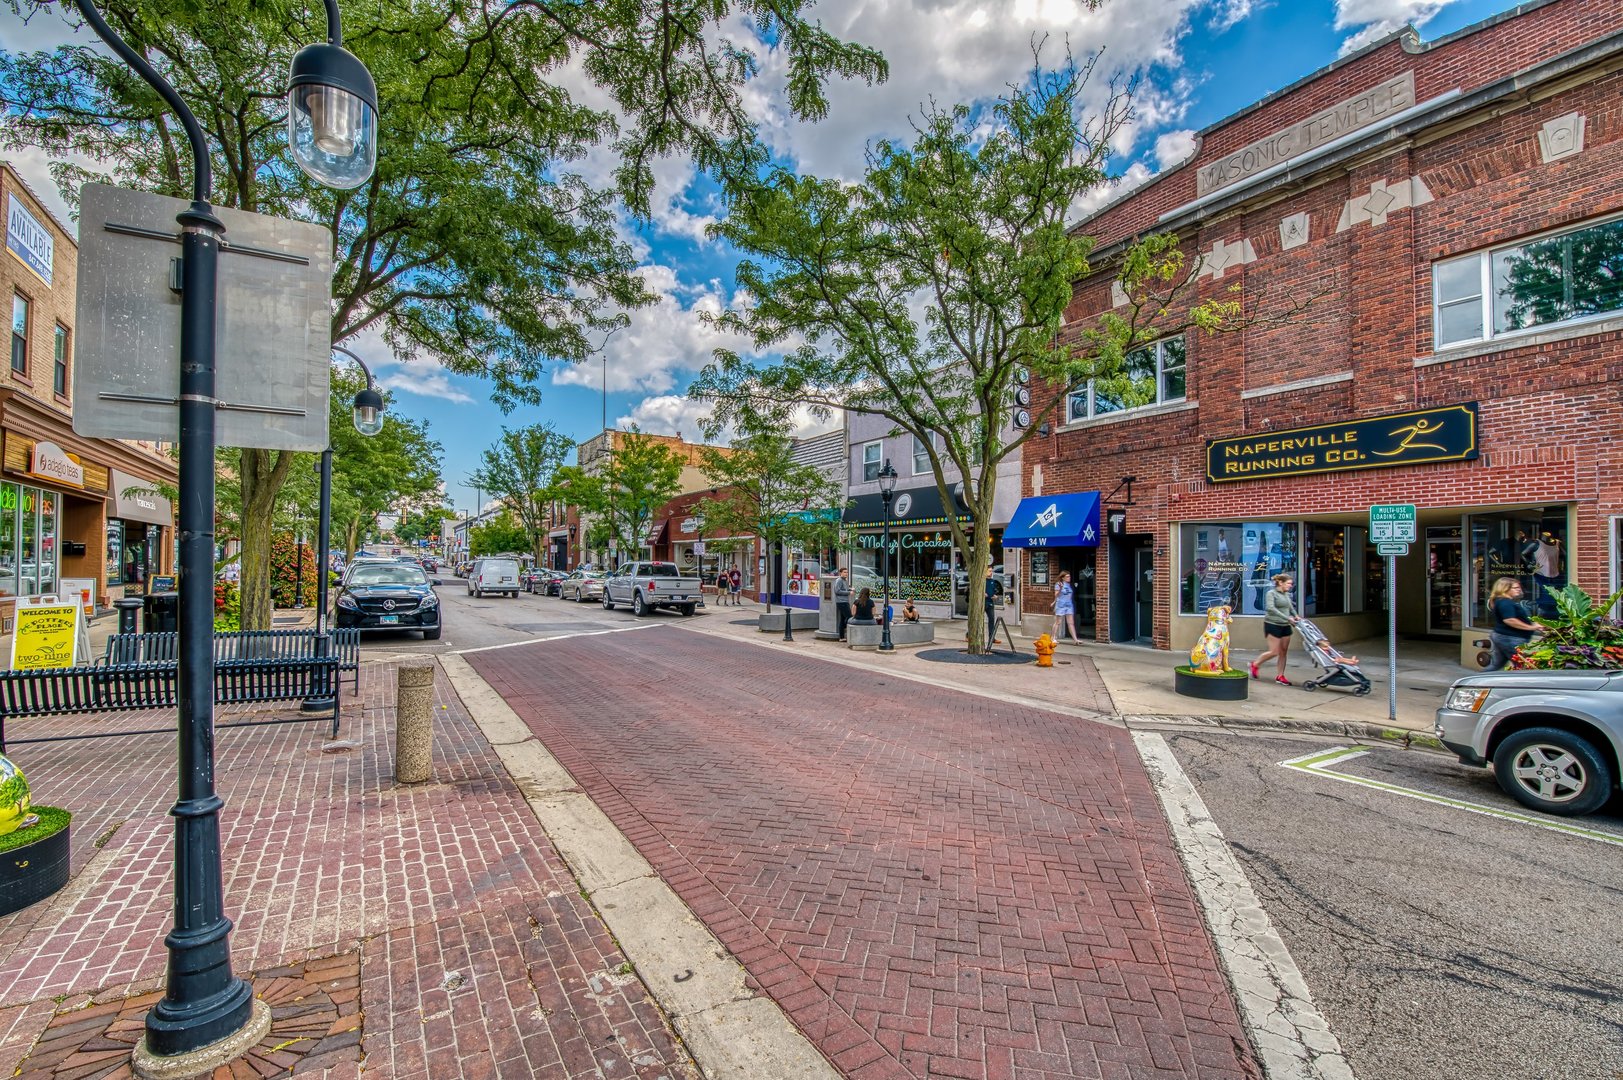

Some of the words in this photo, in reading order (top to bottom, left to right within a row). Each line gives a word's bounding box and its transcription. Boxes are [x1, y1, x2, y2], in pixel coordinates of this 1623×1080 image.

[1201, 131, 1292, 193] MASONIC
[1301, 79, 1408, 146] TEMPLE
[11, 210, 52, 267] AVAILABLE
[1225, 430, 1358, 457] NAPERVILLE
[47, 457, 66, 478] adagio
[66, 463, 79, 479] teas
[1225, 453, 1316, 474] RUNNING
[1325, 448, 1367, 464] CO.
[901, 532, 951, 554] Cupcakes
[1028, 538, 1037, 546] 34
[1038, 537, 1047, 546] W
[18, 652, 70, 662] two-nine
